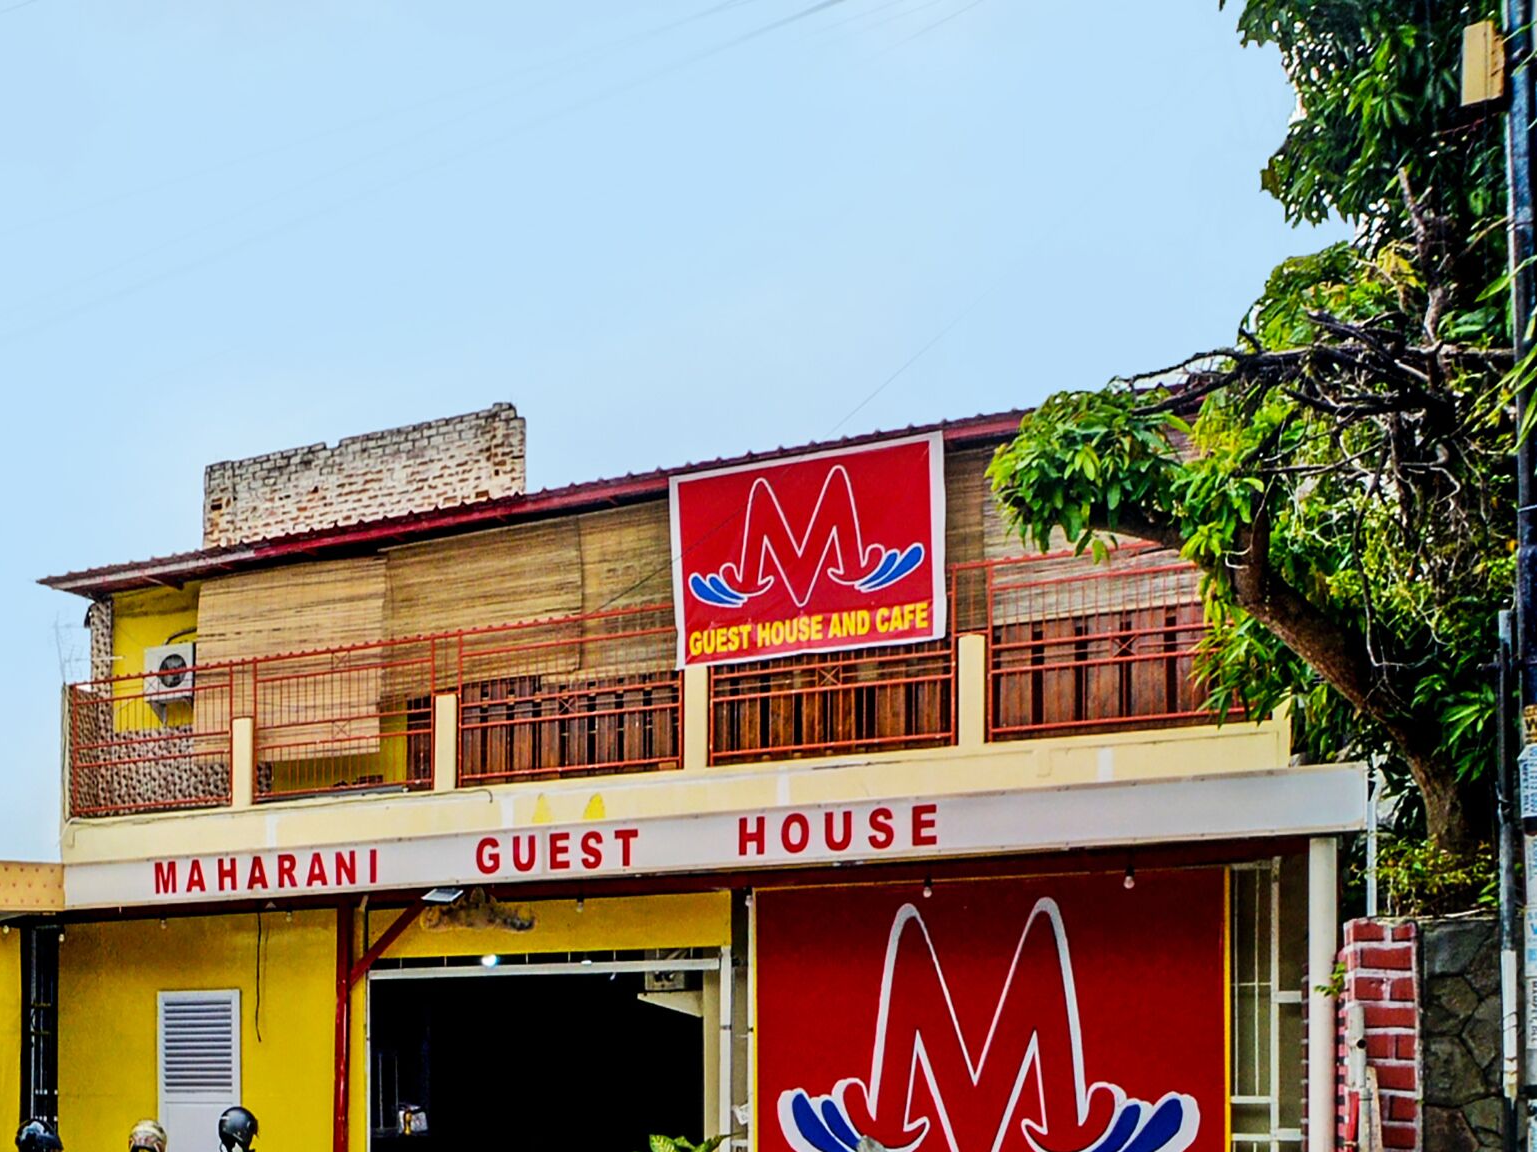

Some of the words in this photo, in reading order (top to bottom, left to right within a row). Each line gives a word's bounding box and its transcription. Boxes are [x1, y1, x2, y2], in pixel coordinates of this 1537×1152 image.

[689, 624, 752, 657] GUEST
[757, 615, 824, 648] HOUSE
[828, 609, 870, 639] AND
[876, 602, 929, 634] CAFE
[154, 848, 378, 894] MAHARANI
[475, 828, 639, 875] GUEST
[738, 803, 938, 856] HOUSE
